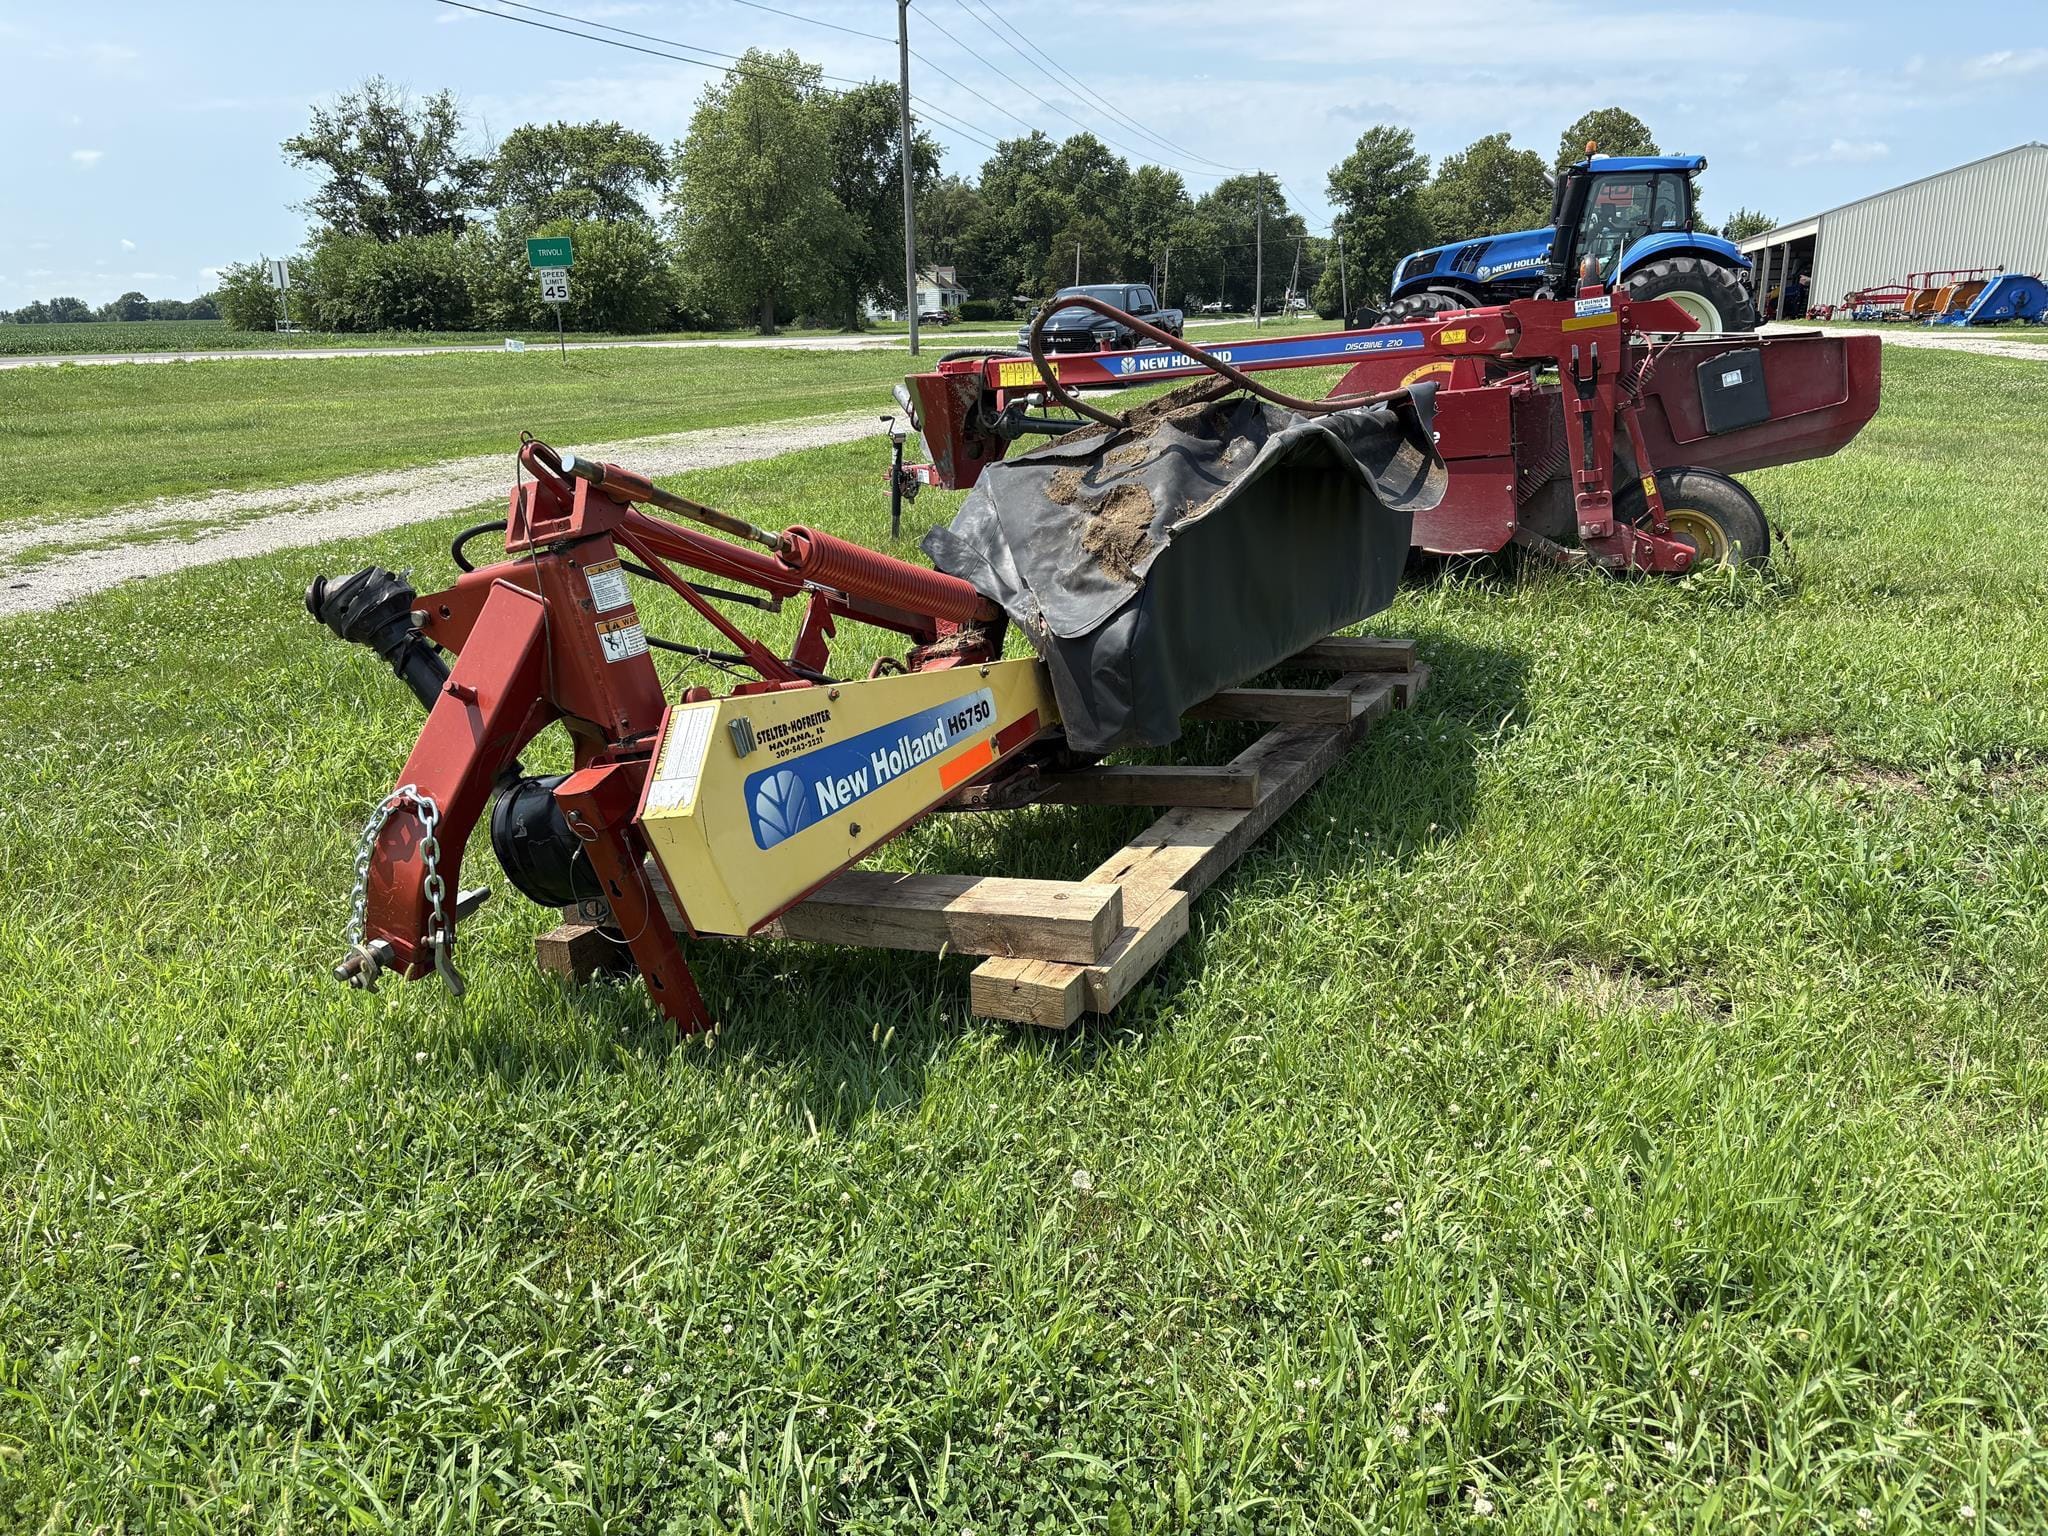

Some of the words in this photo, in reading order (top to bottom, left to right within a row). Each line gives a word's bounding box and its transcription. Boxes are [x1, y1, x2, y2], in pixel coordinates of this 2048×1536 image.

[537, 248, 563, 257] TRIVOLI
[1492, 262, 1512, 274] NEW
[545, 286, 567, 299] 45
[1345, 340, 1383, 351] DISCBINE
[1386, 338, 1403, 348] 210
[1140, 356, 1169, 371] NEW
[768, 731, 815, 752] HAVANA,
[815, 726, 826, 735] IL
[814, 765, 869, 817] New
[869, 716, 948, 786] Holland
[947, 699, 991, 737] H6750
